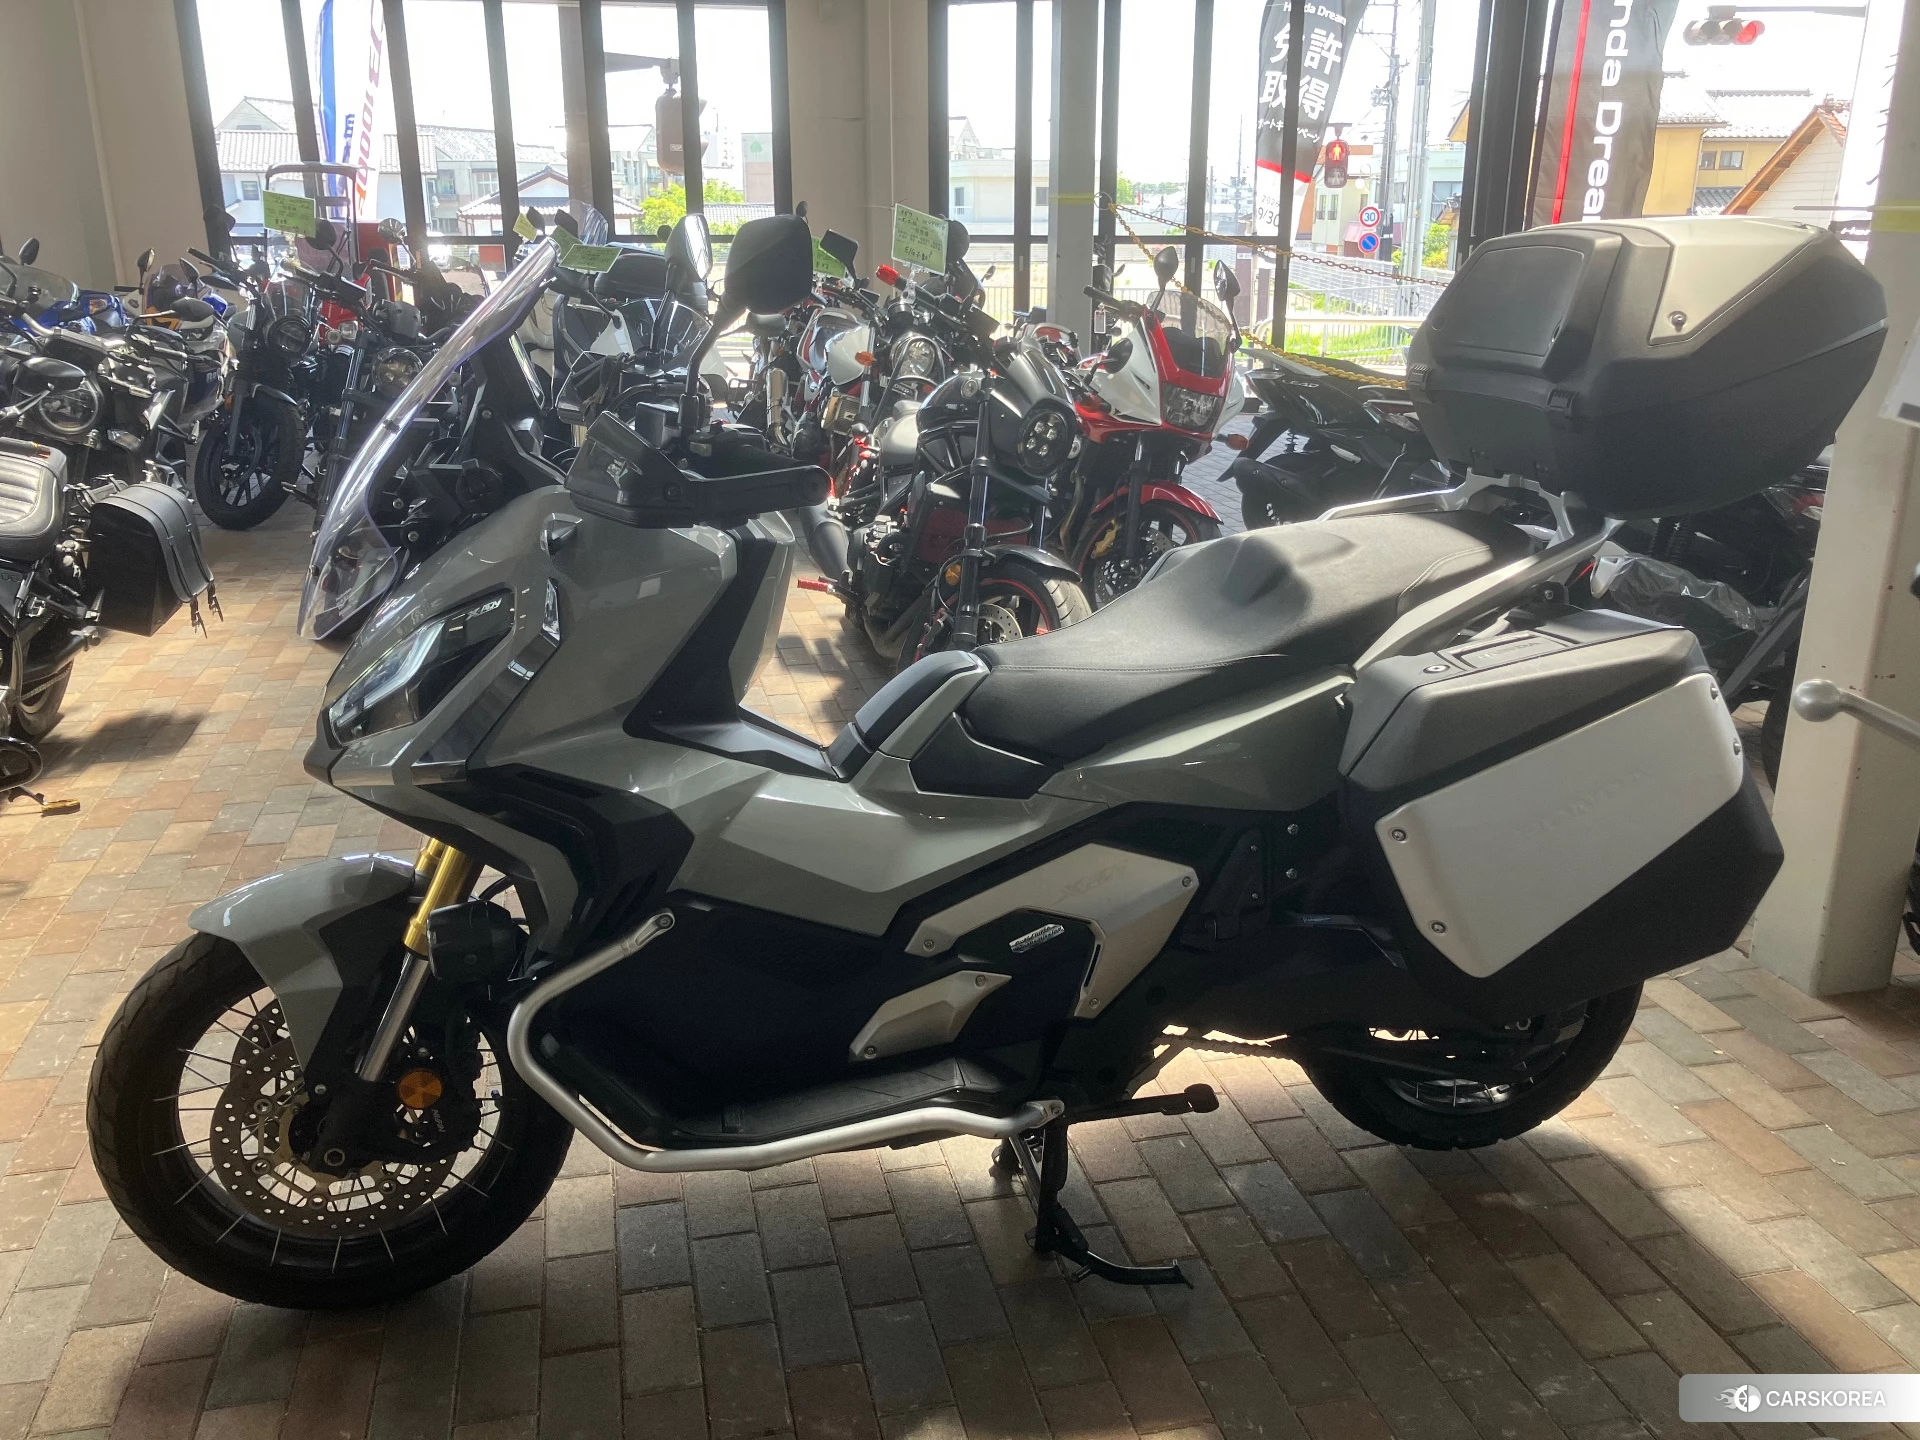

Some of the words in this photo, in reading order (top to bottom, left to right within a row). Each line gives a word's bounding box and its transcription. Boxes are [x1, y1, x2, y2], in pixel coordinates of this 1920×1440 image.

[1283, 2, 1316, 14] Hda
[1317, 5, 1347, 26] Dream
[1258, 206, 1280, 227] 9/30
[1363, 212, 1376, 222] 30
